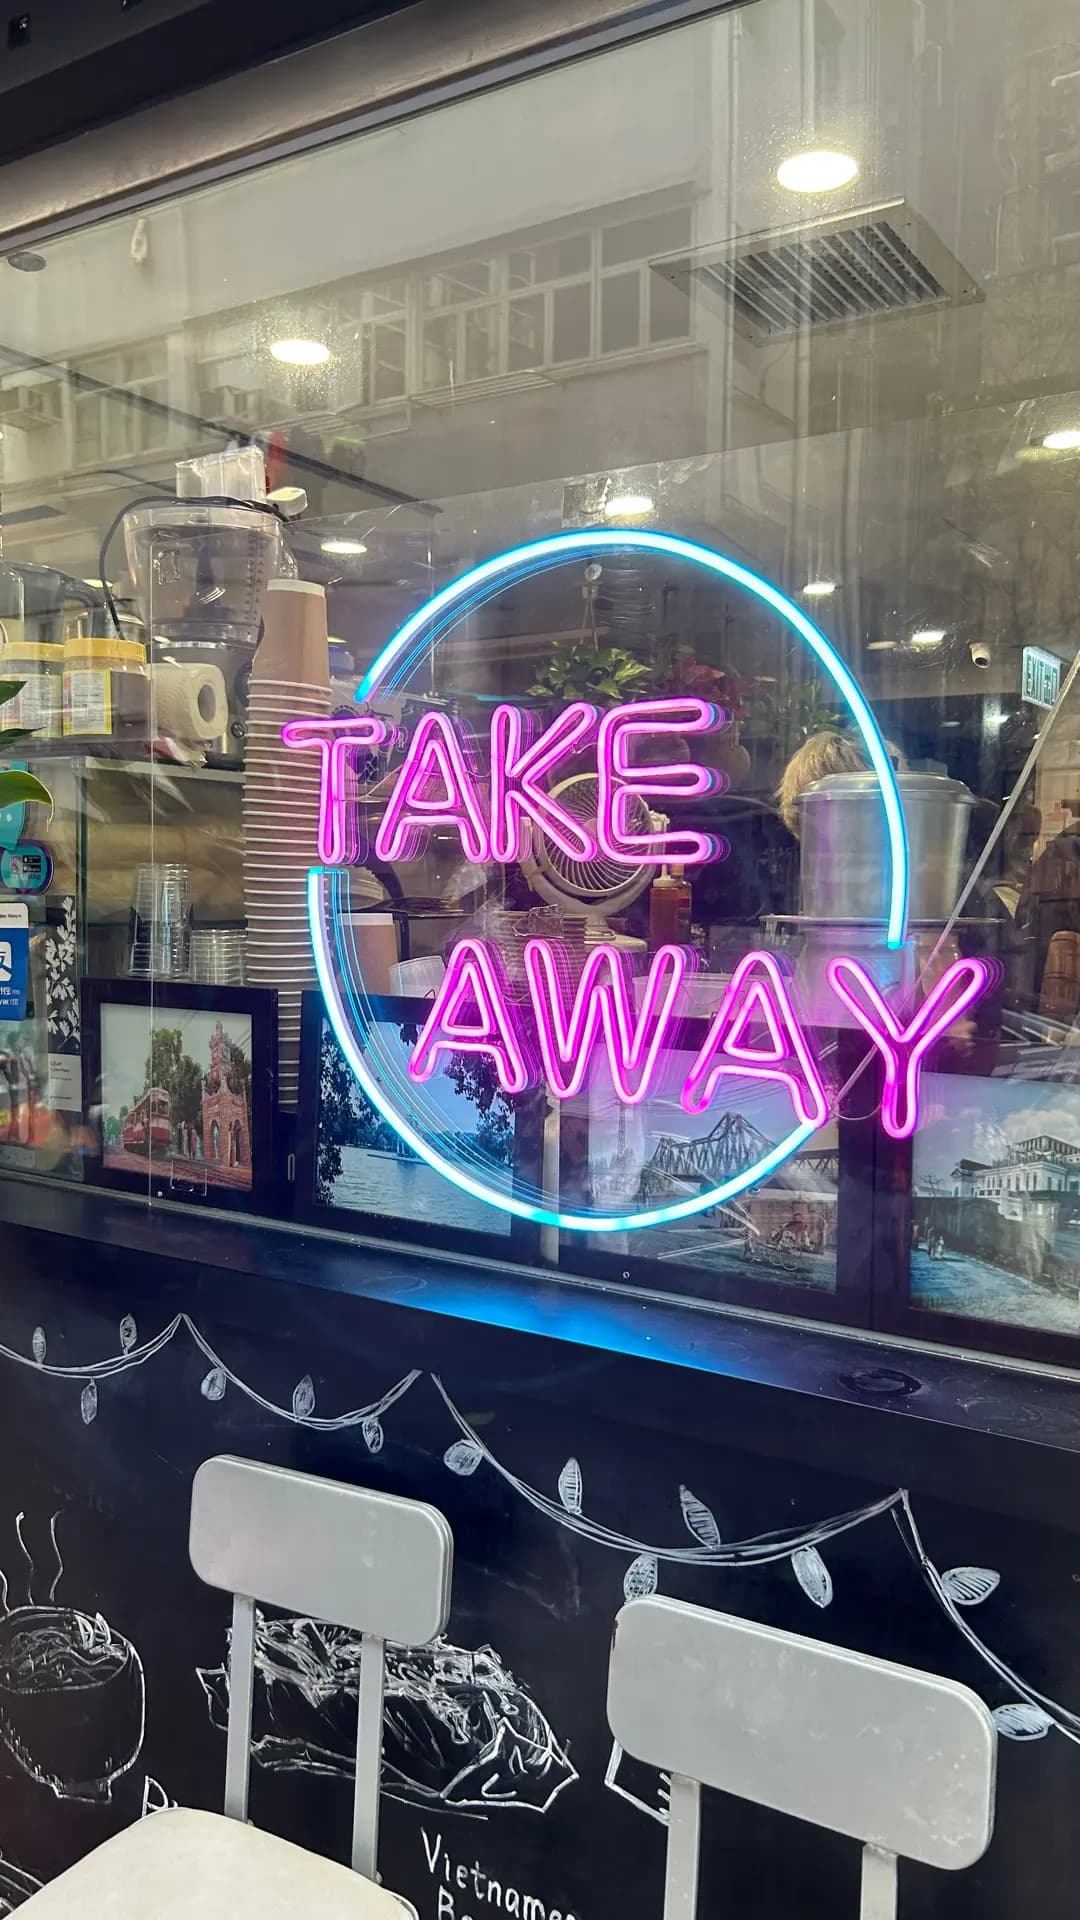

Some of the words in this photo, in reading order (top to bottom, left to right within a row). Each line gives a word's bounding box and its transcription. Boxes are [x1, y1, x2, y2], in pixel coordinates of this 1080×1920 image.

[1026, 654, 1045, 702] EXIT
[281, 698, 711, 865] TAKE
[408, 938, 988, 1139] AWAY
